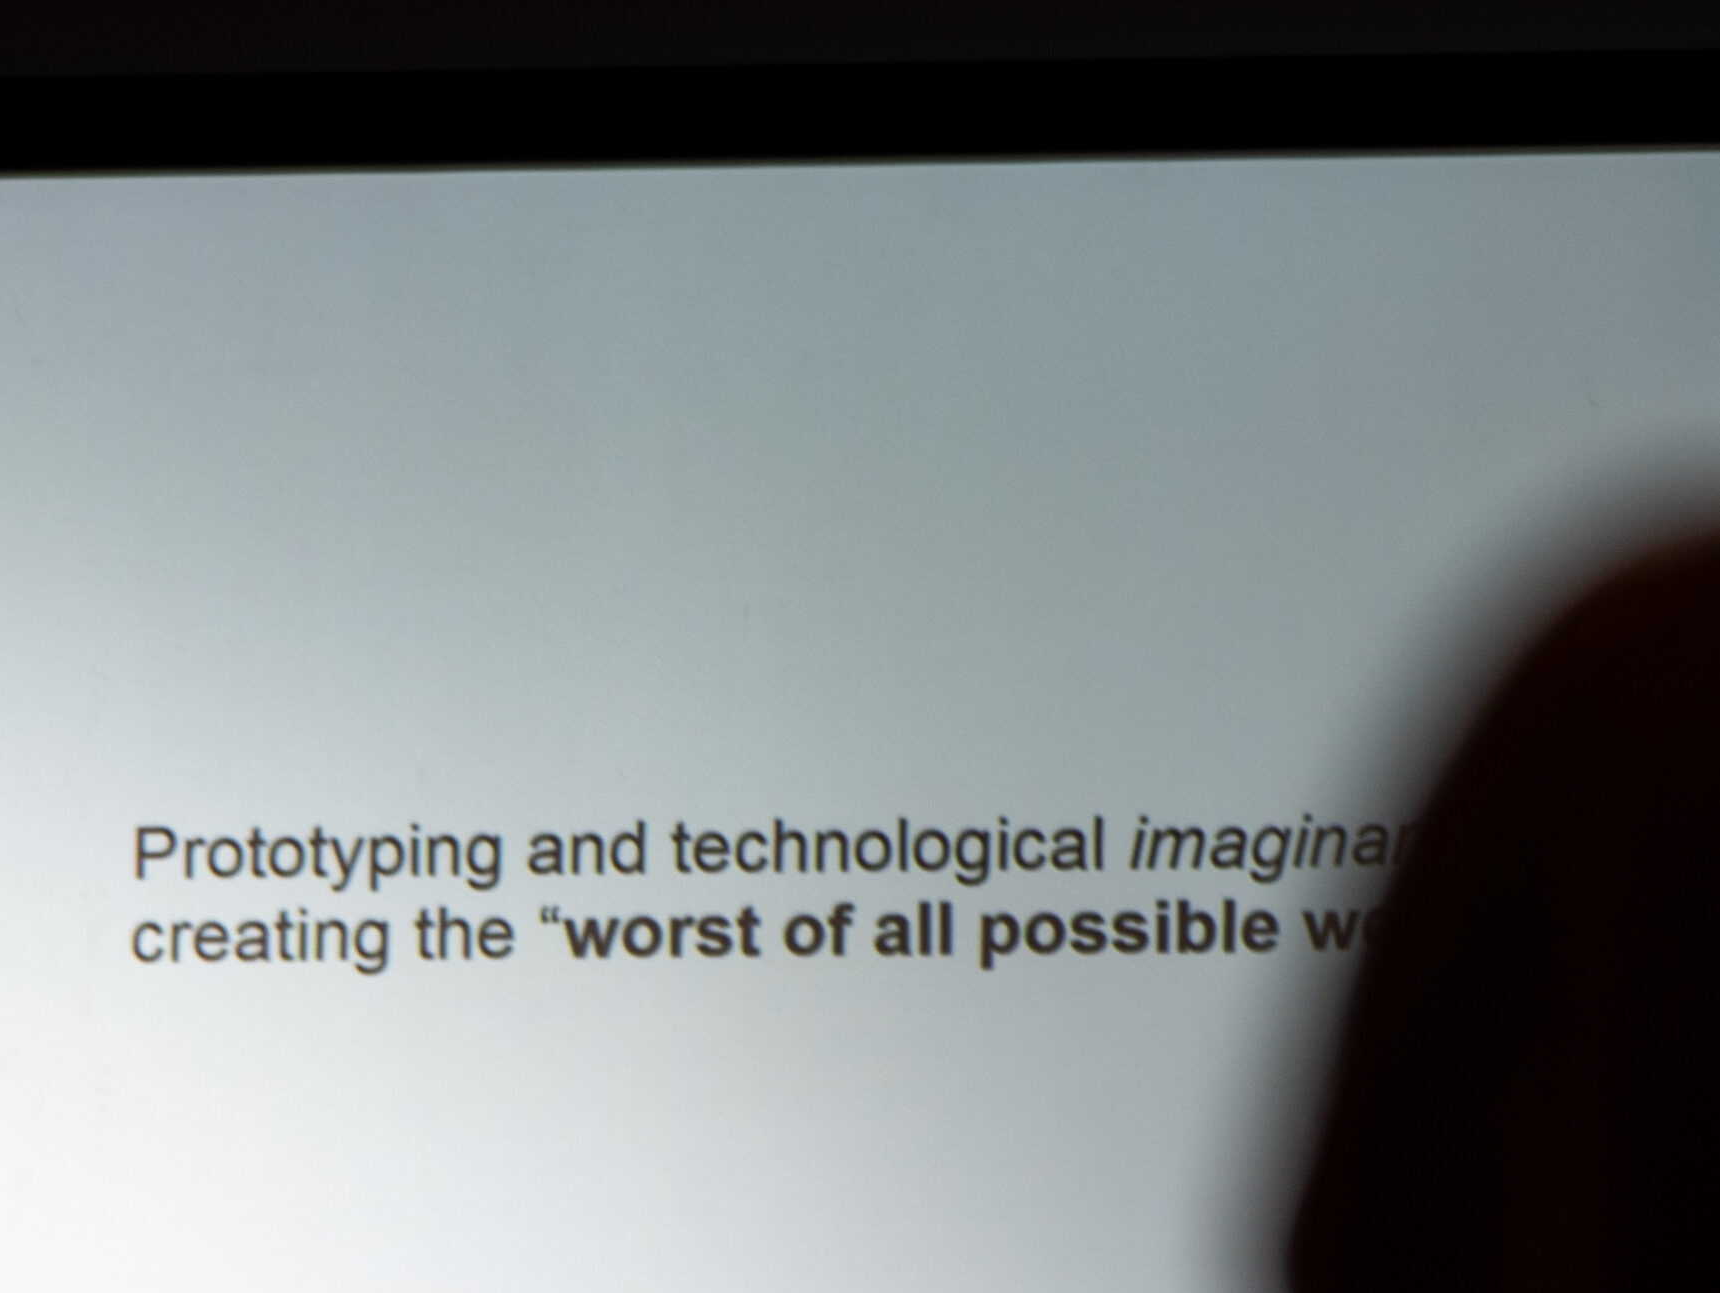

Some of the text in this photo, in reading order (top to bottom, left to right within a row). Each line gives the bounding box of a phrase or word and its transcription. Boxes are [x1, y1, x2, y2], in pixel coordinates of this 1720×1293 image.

[132, 822, 503, 894] Prototyping
[527, 819, 648, 876] and
[670, 814, 1105, 886] technological
[130, 905, 392, 976] creating
[414, 905, 515, 961] the
[539, 902, 762, 961] “worst
[782, 900, 855, 957] of
[874, 900, 953, 957] all
[979, 897, 1280, 971] possible
